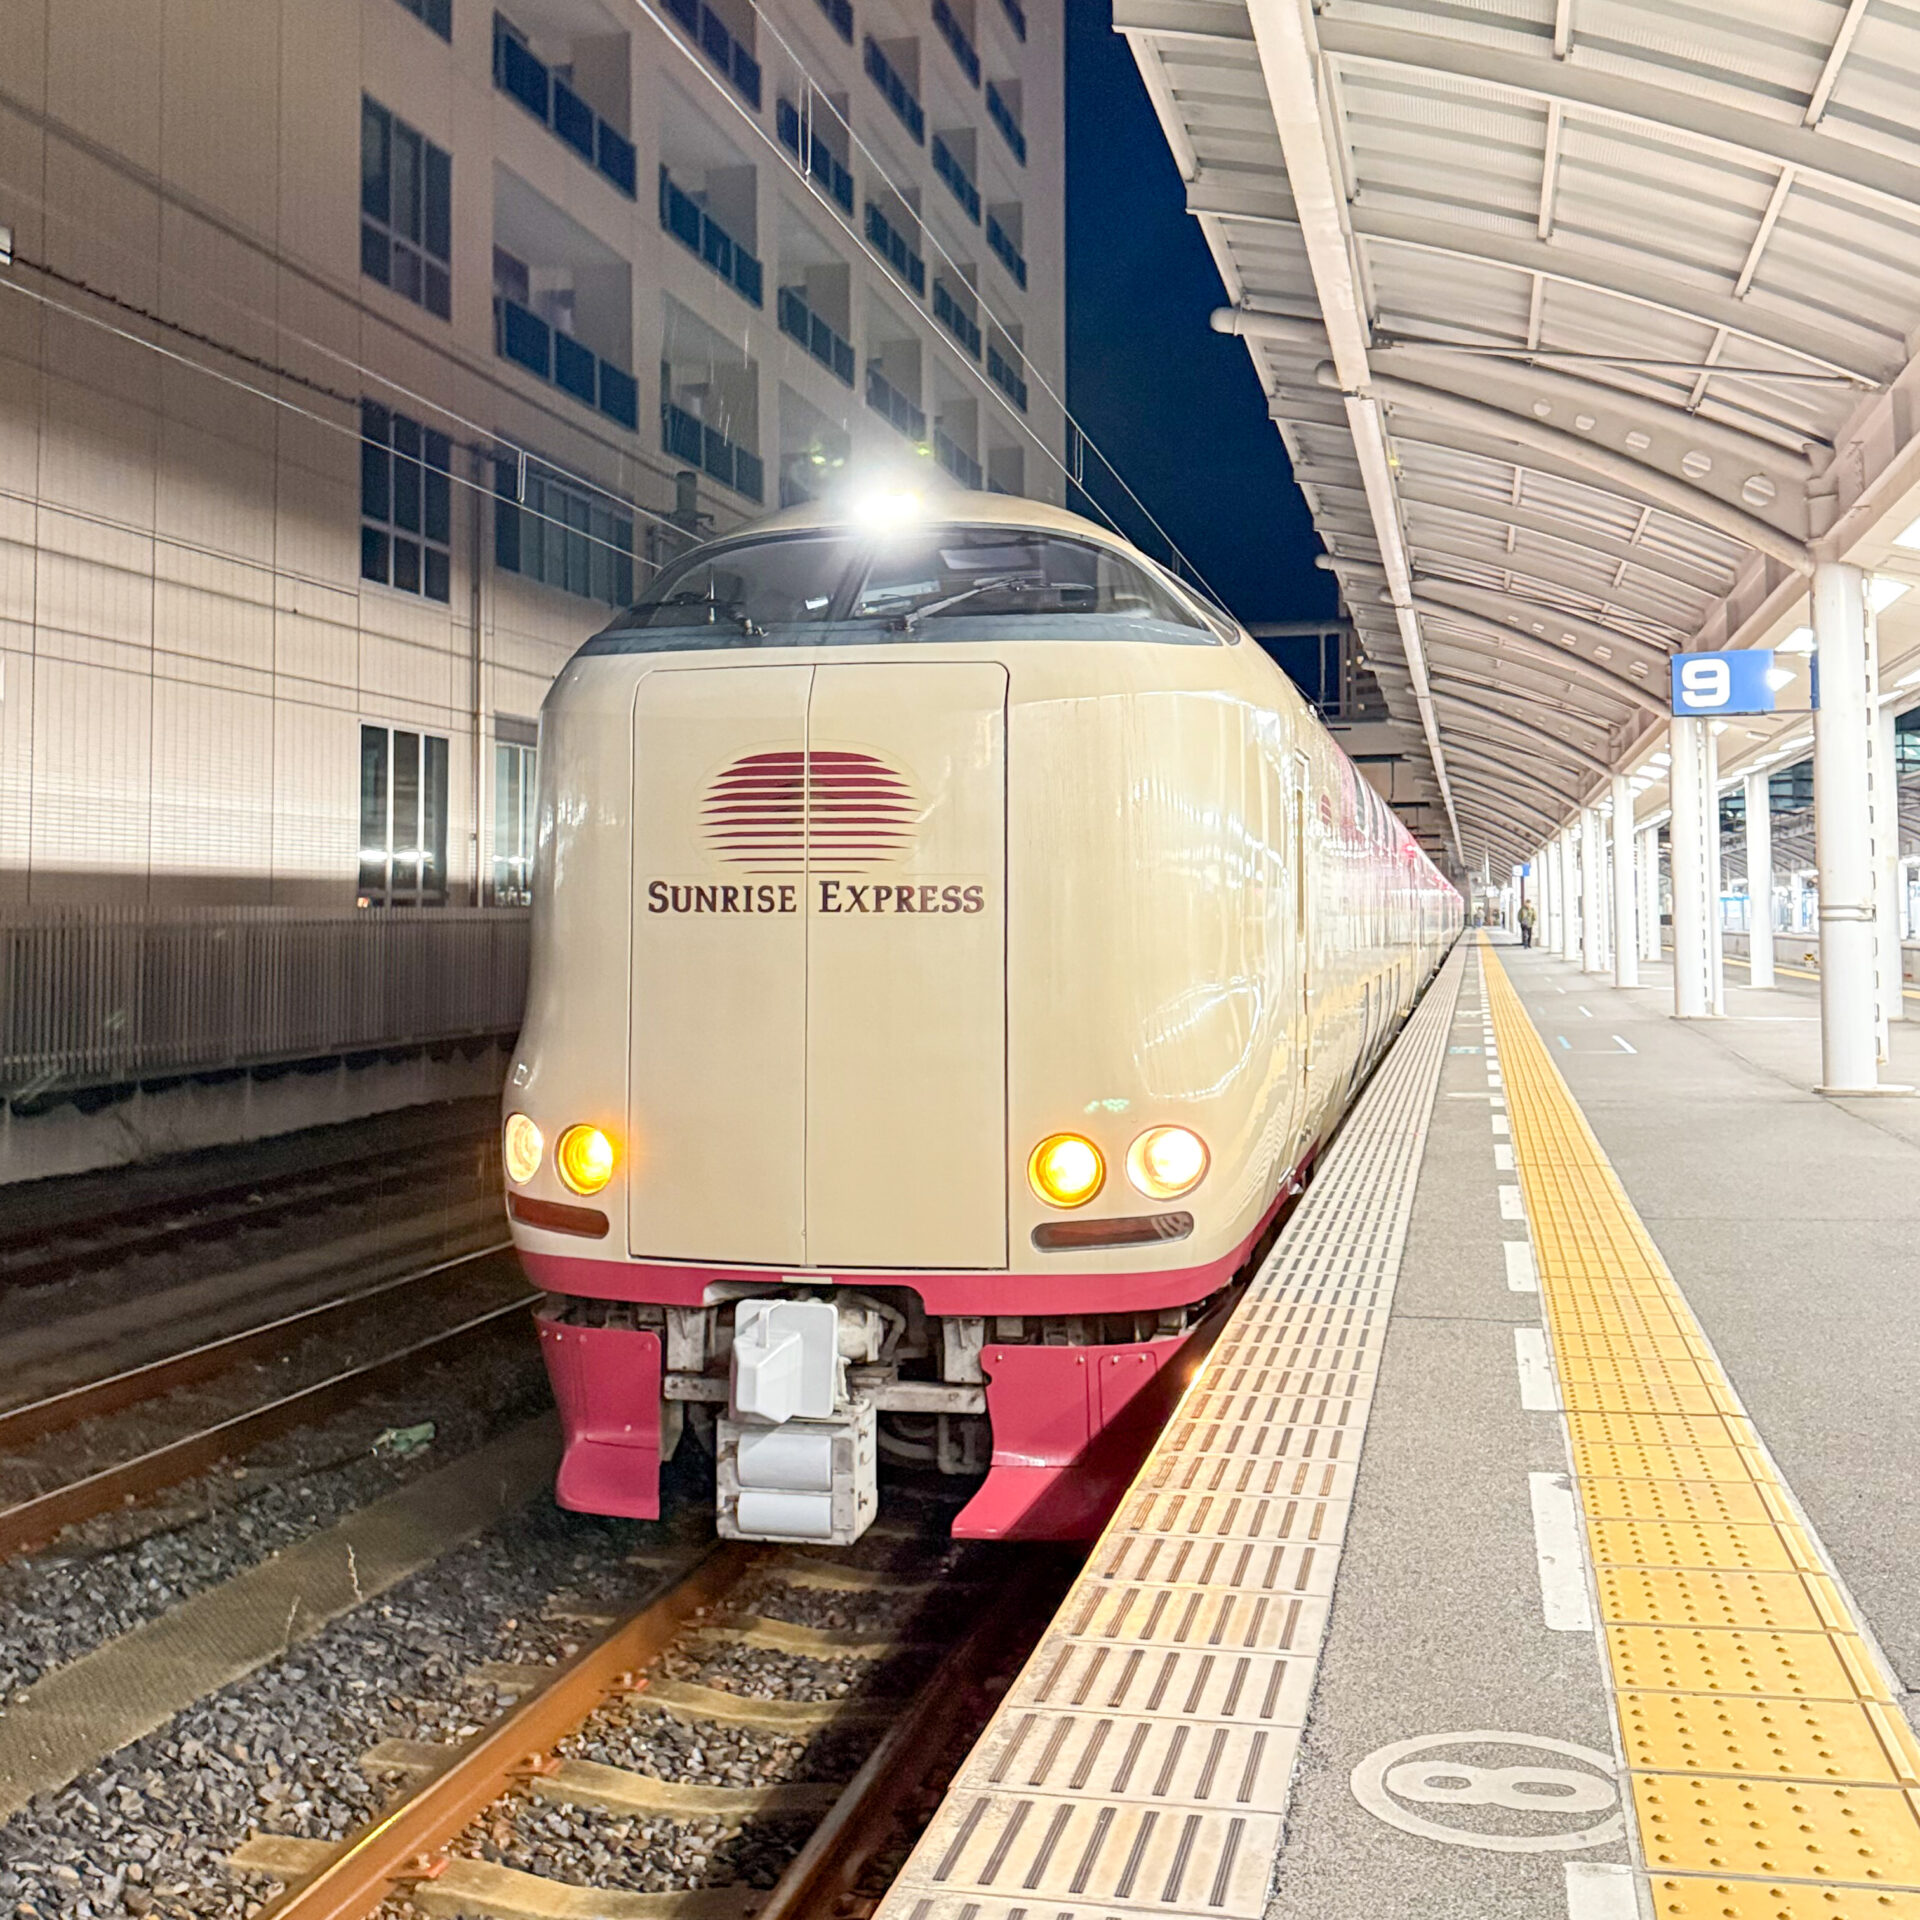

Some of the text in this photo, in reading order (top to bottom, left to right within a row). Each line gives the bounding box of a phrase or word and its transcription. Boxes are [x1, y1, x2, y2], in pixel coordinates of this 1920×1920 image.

[1681, 658, 1731, 708] 9
[647, 880, 985, 914] SUNRISE EXPRESS
[1385, 1760, 1618, 1813] 8
